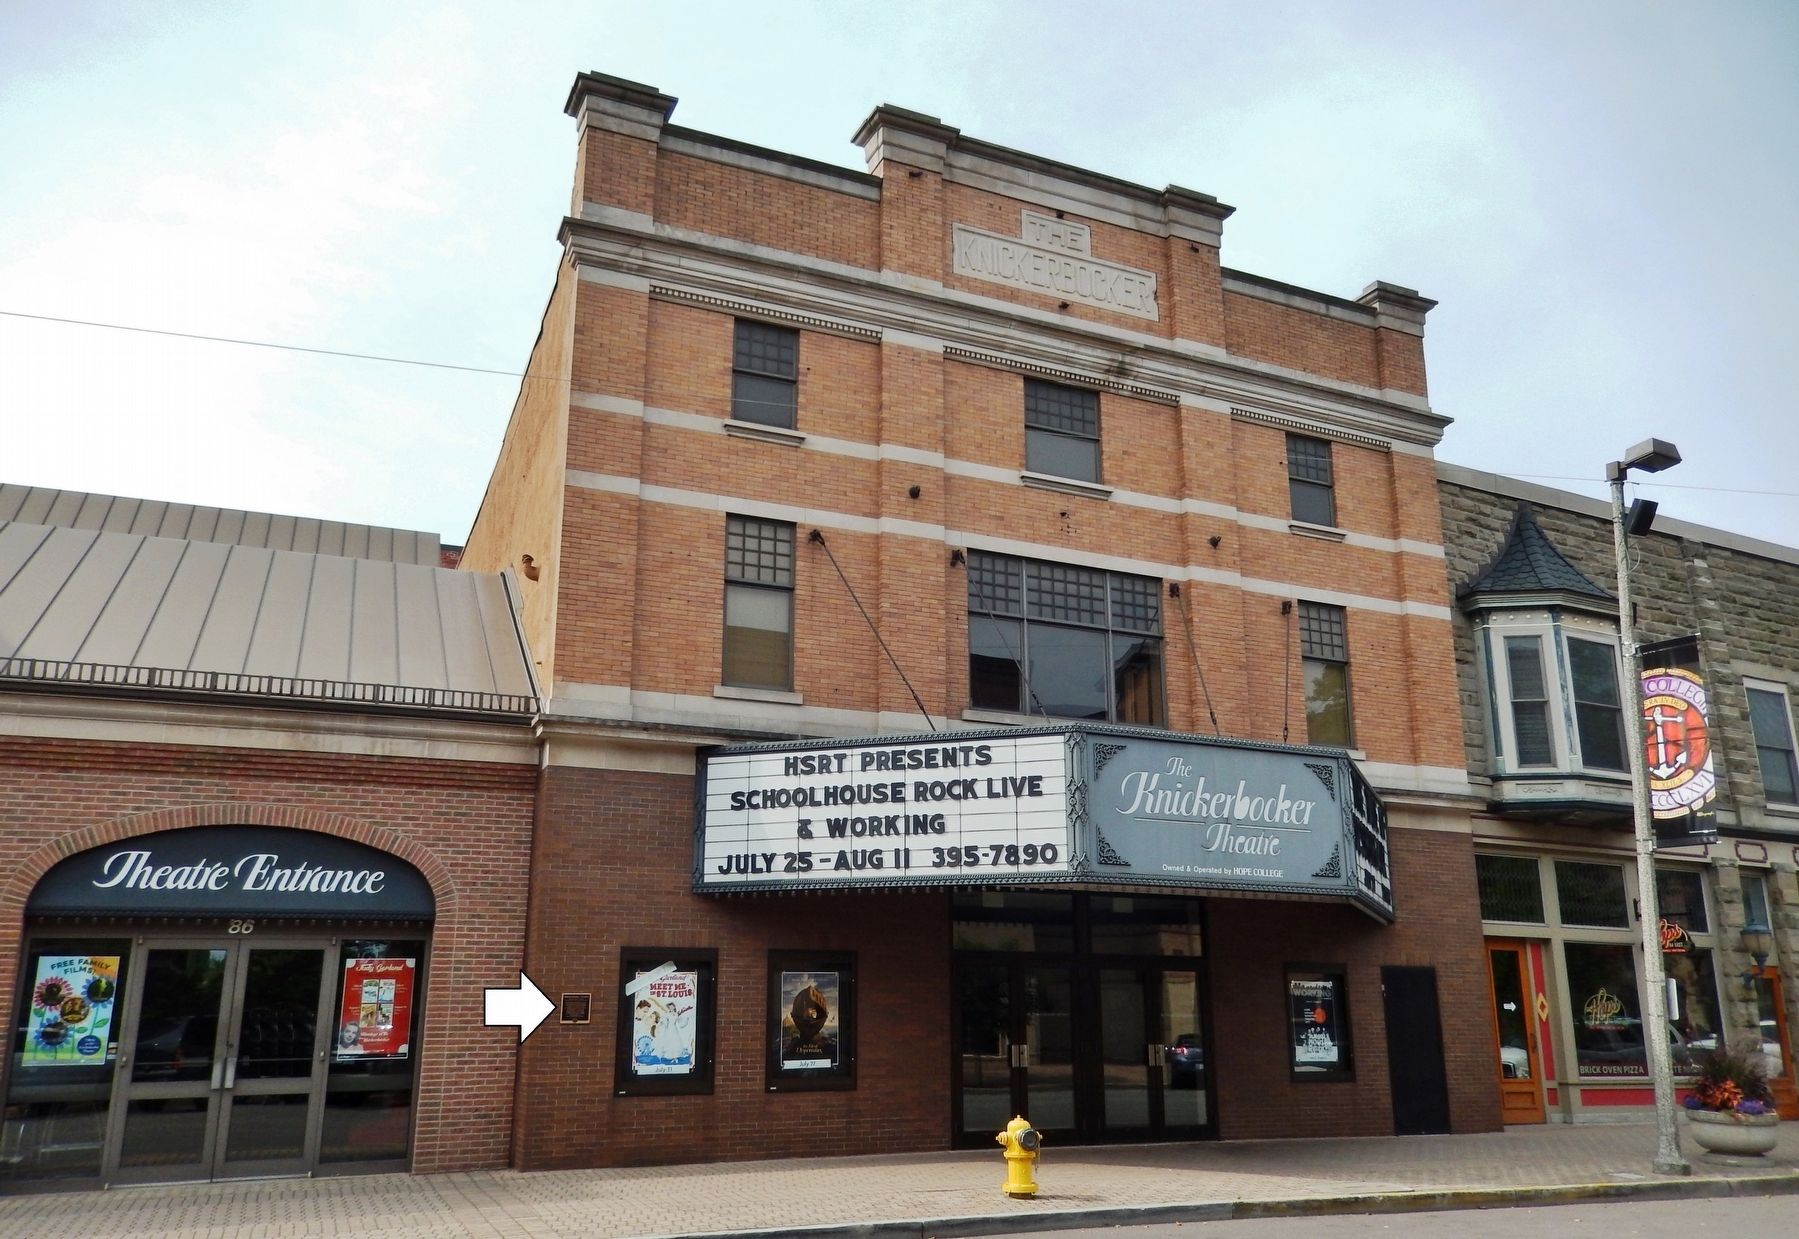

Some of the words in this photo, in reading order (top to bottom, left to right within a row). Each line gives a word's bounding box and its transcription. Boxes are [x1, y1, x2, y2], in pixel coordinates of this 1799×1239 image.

[1029, 221, 1083, 252] THE
[959, 234, 1152, 313] KNICKERBOCKER
[784, 753, 847, 776] HSRT
[861, 745, 992, 772] PRESENTS
[1165, 756, 1192, 777] The
[731, 782, 906, 811] SCHOOLHOUSE
[914, 778, 978, 802] ROCK
[987, 775, 1043, 799] LIVE
[1116, 771, 1316, 825] Knickerbocker
[797, 818, 813, 839] &
[826, 814, 946, 839] WORKING
[1201, 823, 1281, 855] Theatre
[718, 853, 776, 874] JULY
[784, 852, 813, 872] 25
[894, 848, 910, 869] 11
[932, 843, 1058, 868] 395-7890
[1162, 864, 1184, 872] Owned
[1193, 866, 1222, 874] Operated
[1224, 867, 1232, 875] by
[1234, 867, 1253, 876] HOPE
[92, 851, 229, 891] Theatre
[234, 854, 385, 894] Entrance
[228, 919, 255, 934] 86
[50, 960, 75, 970] FREE
[78, 958, 111, 970] FAMILY
[63, 966, 96, 975] FILMS!
[650, 983, 673, 991] MEET
[668, 988, 693, 998] LOUIS
[1579, 1065, 1601, 1074] BRICK
[1602, 1065, 1623, 1074] OVEN
[1623, 1065, 1645, 1074] PIZZA
